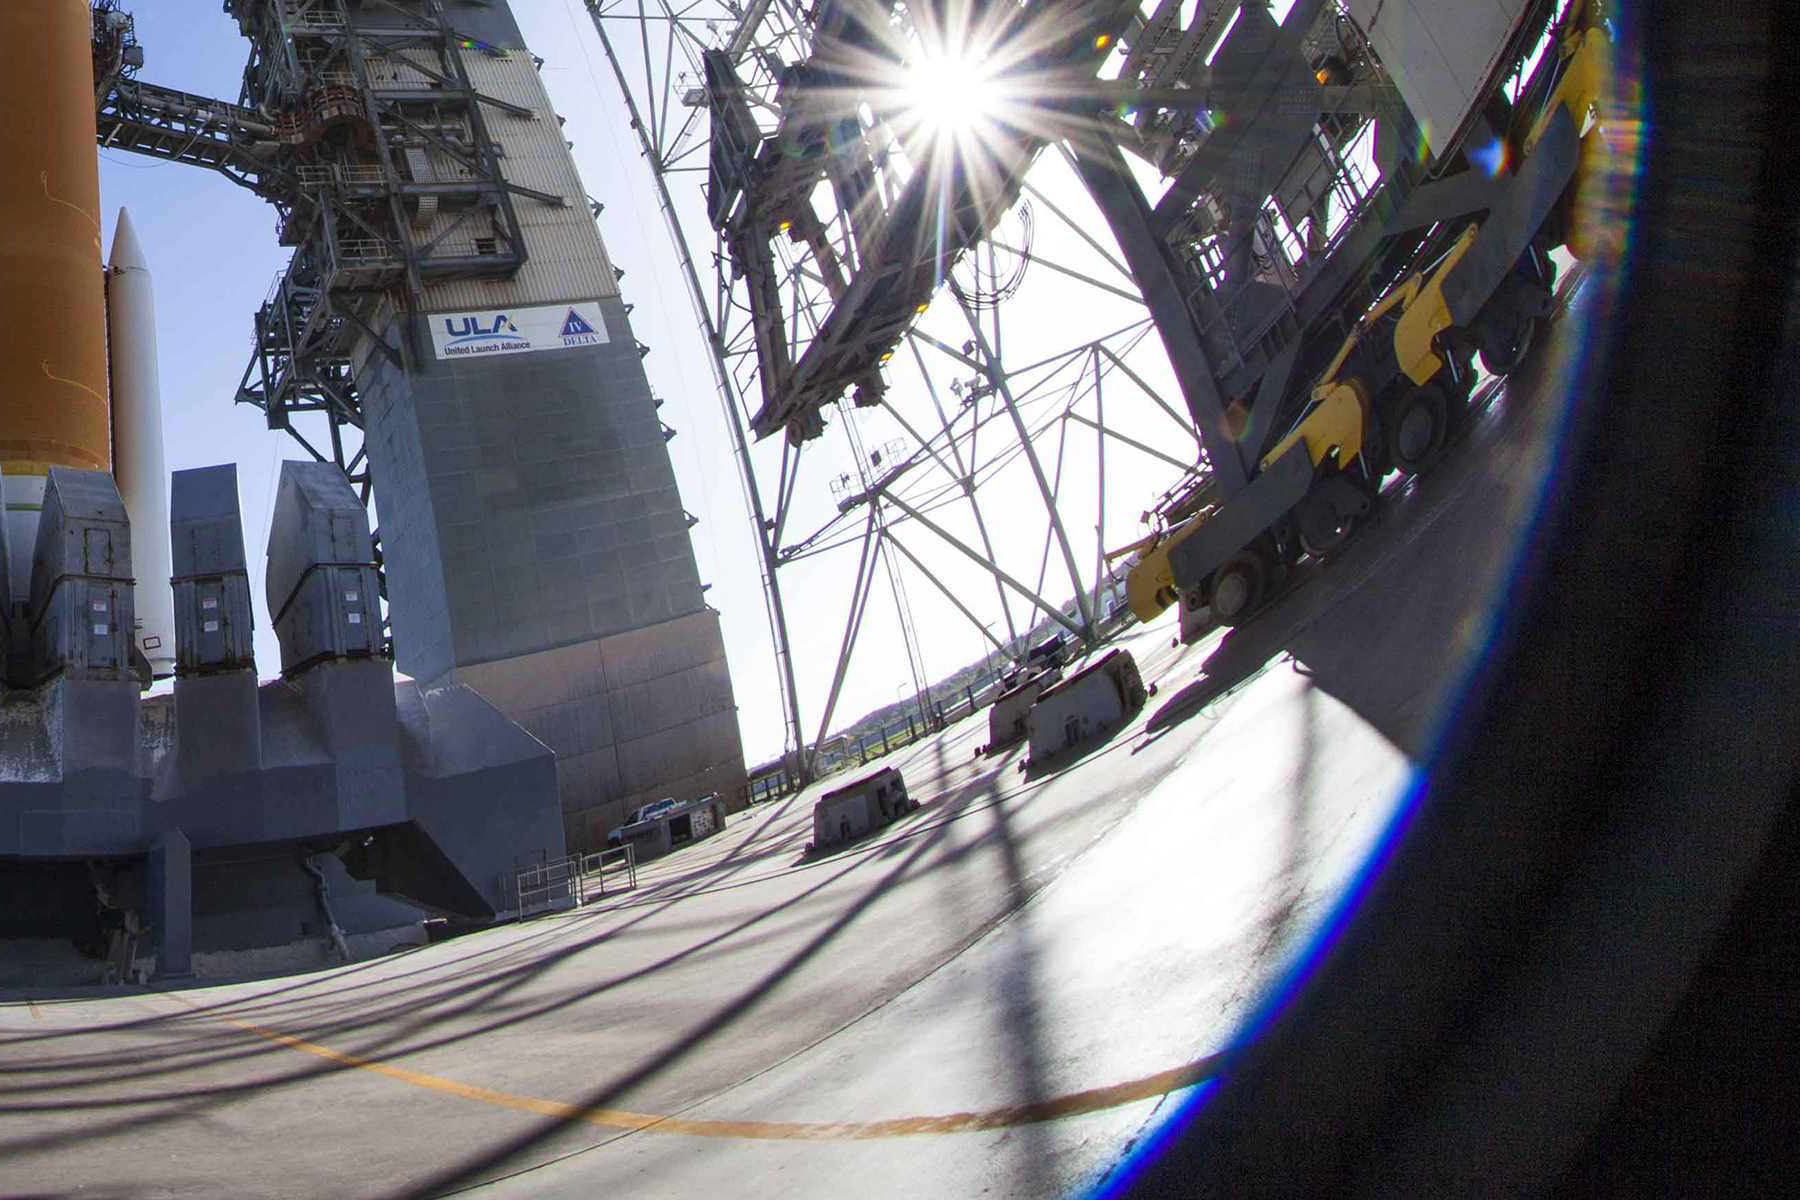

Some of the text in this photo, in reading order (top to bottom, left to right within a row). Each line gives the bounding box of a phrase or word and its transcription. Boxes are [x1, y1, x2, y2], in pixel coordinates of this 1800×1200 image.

[445, 314, 518, 336] ULA
[568, 320, 582, 333] IV
[563, 335, 597, 346] DELTA
[444, 341, 531, 356] United Launch Alliance
